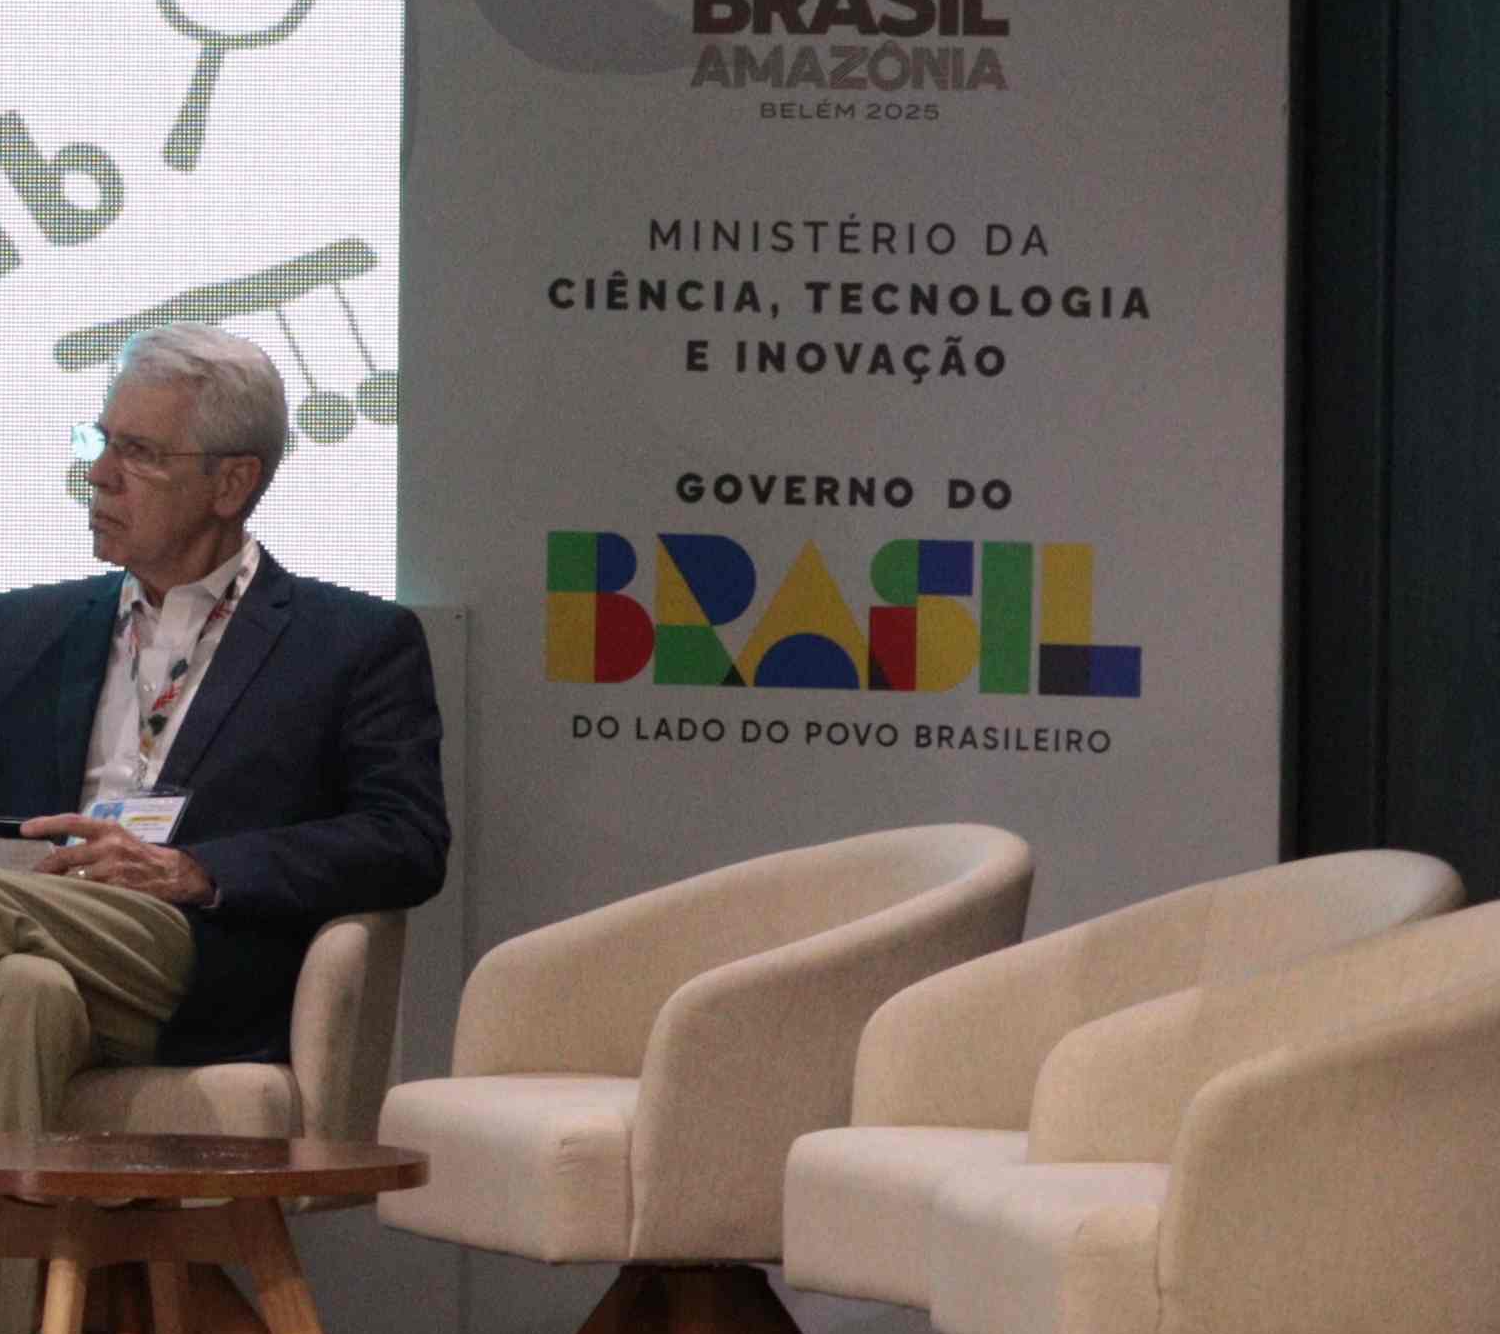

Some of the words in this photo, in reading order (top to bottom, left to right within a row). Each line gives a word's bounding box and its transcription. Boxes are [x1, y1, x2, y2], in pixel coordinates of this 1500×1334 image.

[691, 37, 1010, 91] AMAZÔNIA
[760, 96, 857, 120] BELÉM
[866, 101, 940, 121] 2025
[649, 213, 957, 256] MINISTÉRIO
[986, 223, 1049, 257] DA
[547, 270, 780, 318] CIÊNCIA,
[806, 281, 1151, 320] TECNOLOGIA
[686, 340, 708, 372] E
[735, 336, 1006, 385] INOVAÇÃO
[675, 472, 915, 509] GOVERNO
[947, 477, 1013, 510] DO
[545, 529, 1142, 698] BRASIL
[571, 714, 619, 740] DO
[634, 716, 725, 743] LADO
[741, 719, 789, 745] DO
[805, 721, 899, 748] POVO
[915, 724, 1111, 754] BRASILEIRO
